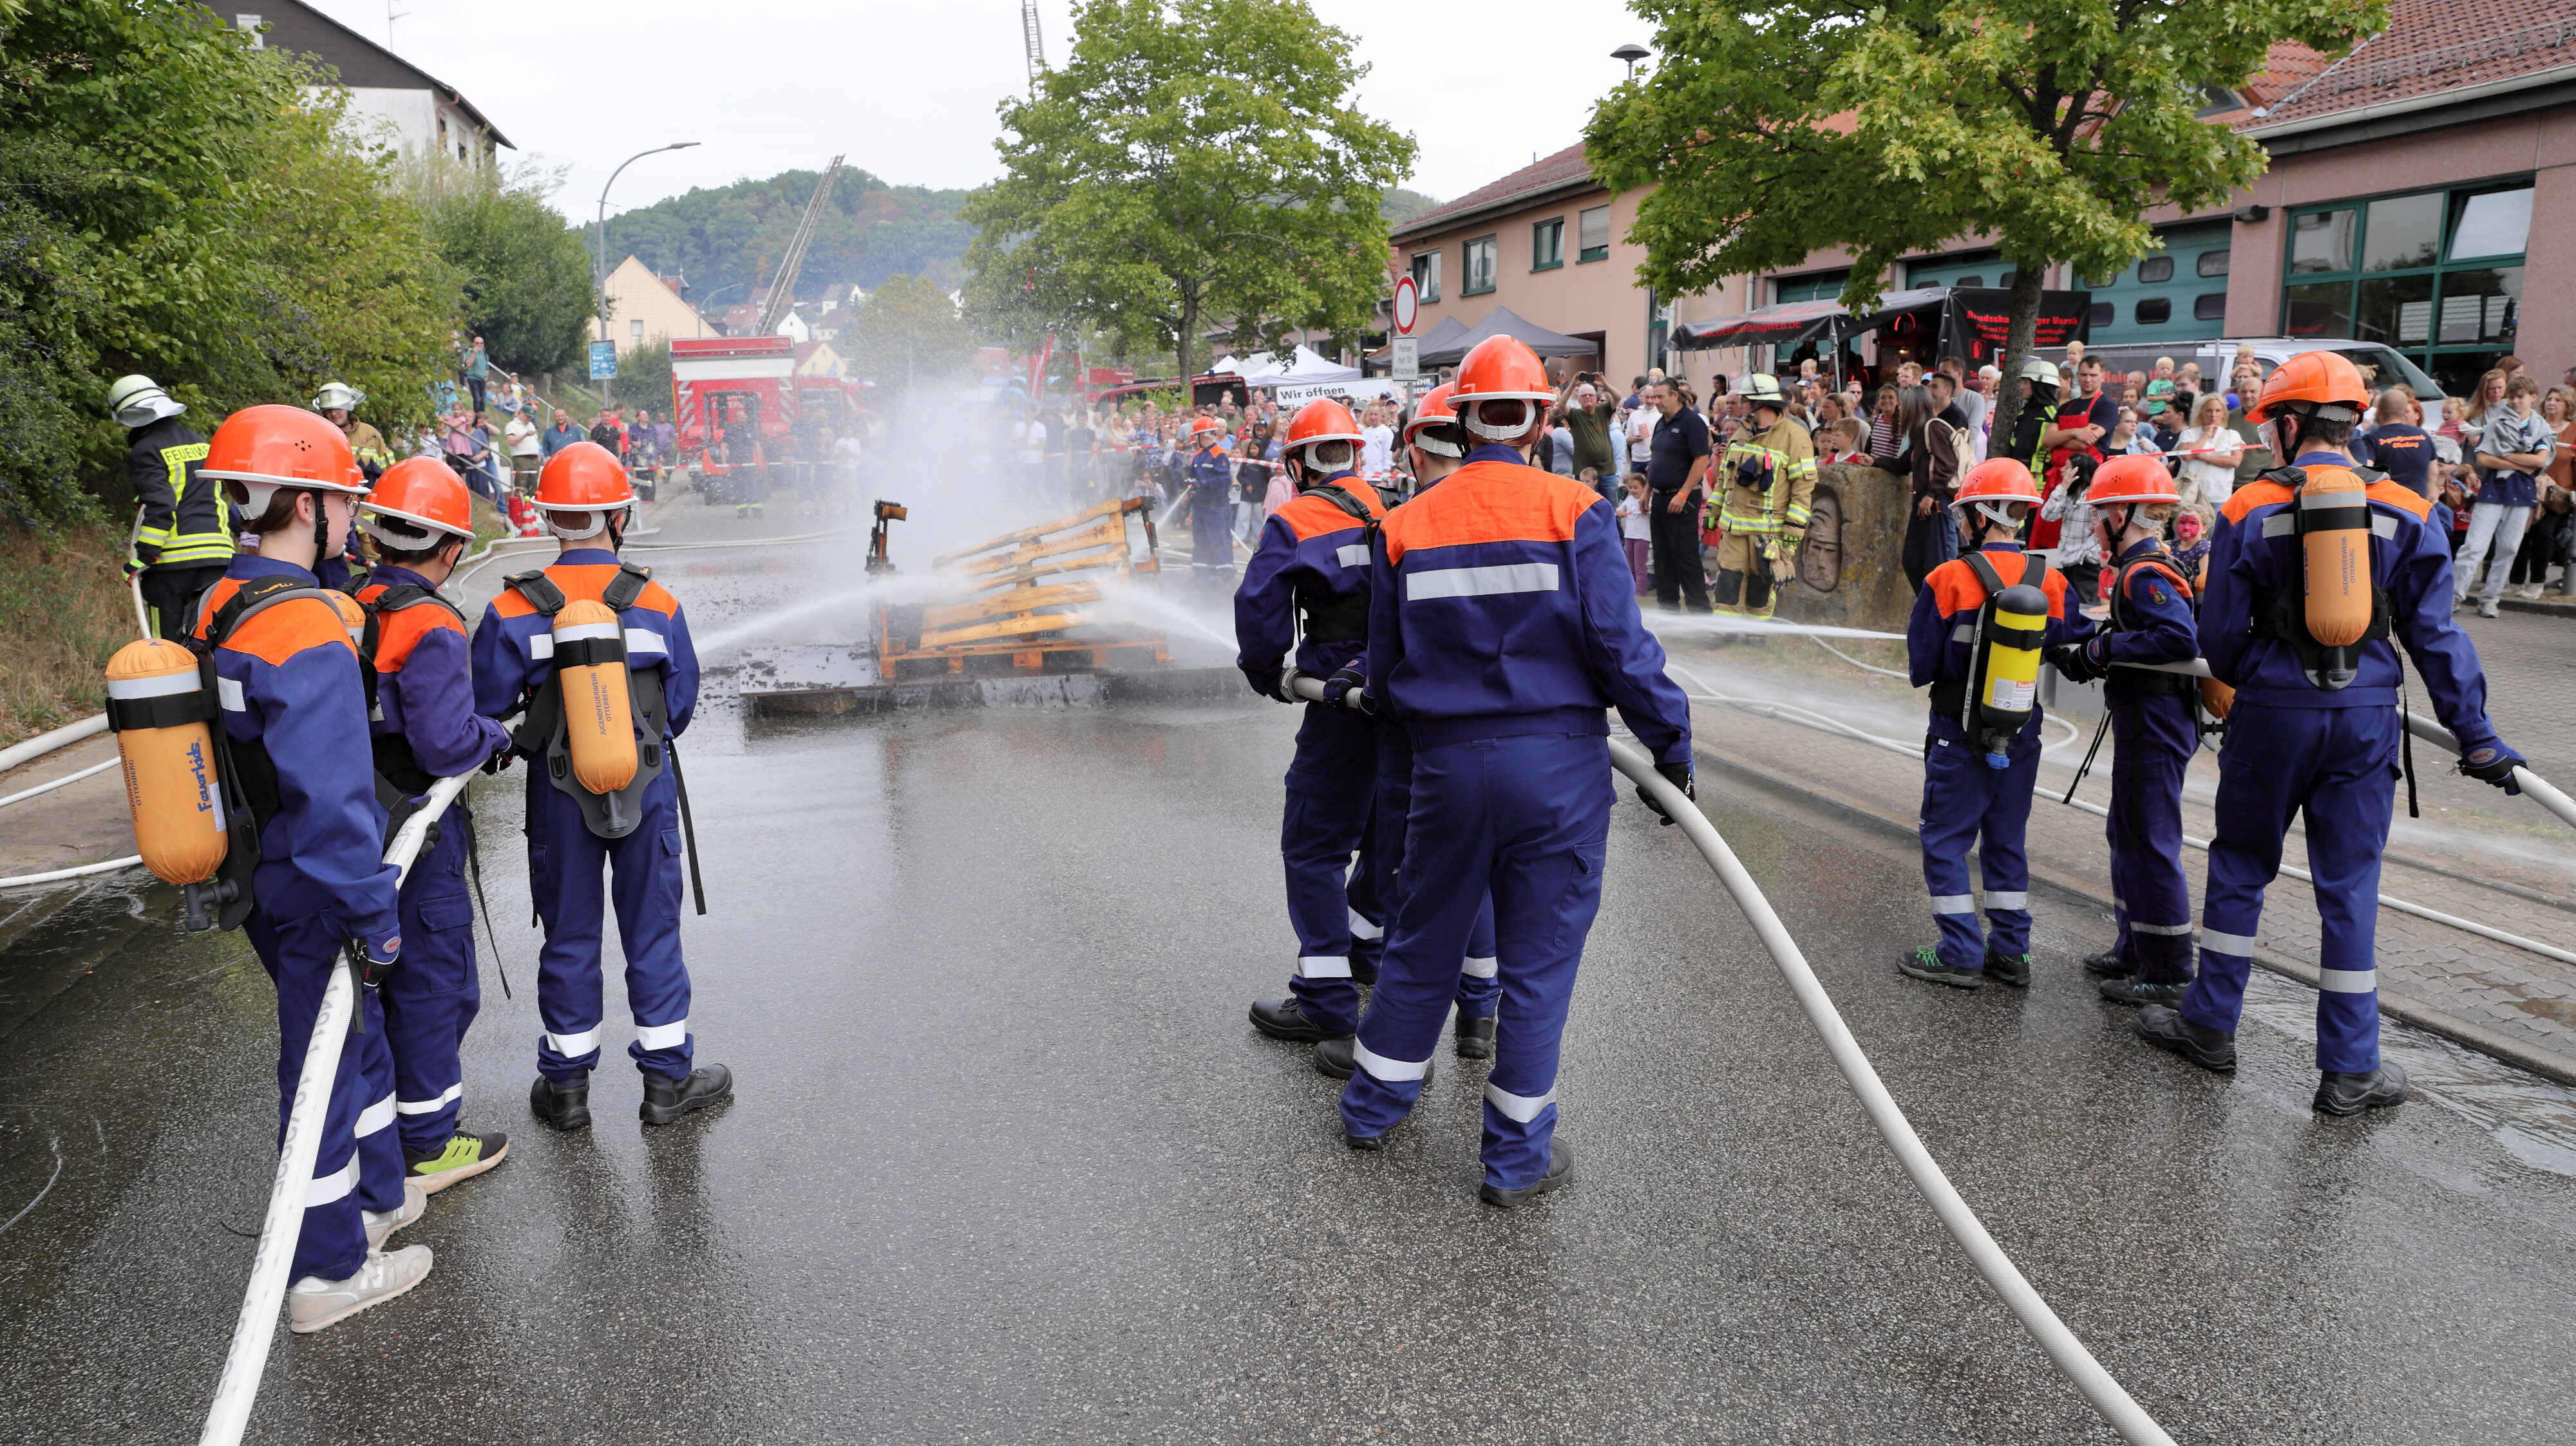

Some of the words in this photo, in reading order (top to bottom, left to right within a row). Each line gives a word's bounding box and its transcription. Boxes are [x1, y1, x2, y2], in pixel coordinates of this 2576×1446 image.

[1280, 389, 1303, 400] Wir
[1306, 386, 1345, 398] öffnen
[164, 446, 210, 463] FEUERWE
[2340, 536, 2349, 596] JUGENDFEUERWEHR
[591, 672, 607, 735] JUGENDFEUERWEHR
[601, 684, 612, 722] OTTERBERG
[119, 742, 139, 822] JUGENDFEUERWEHR
[129, 759, 142, 806] OTTERBERG
